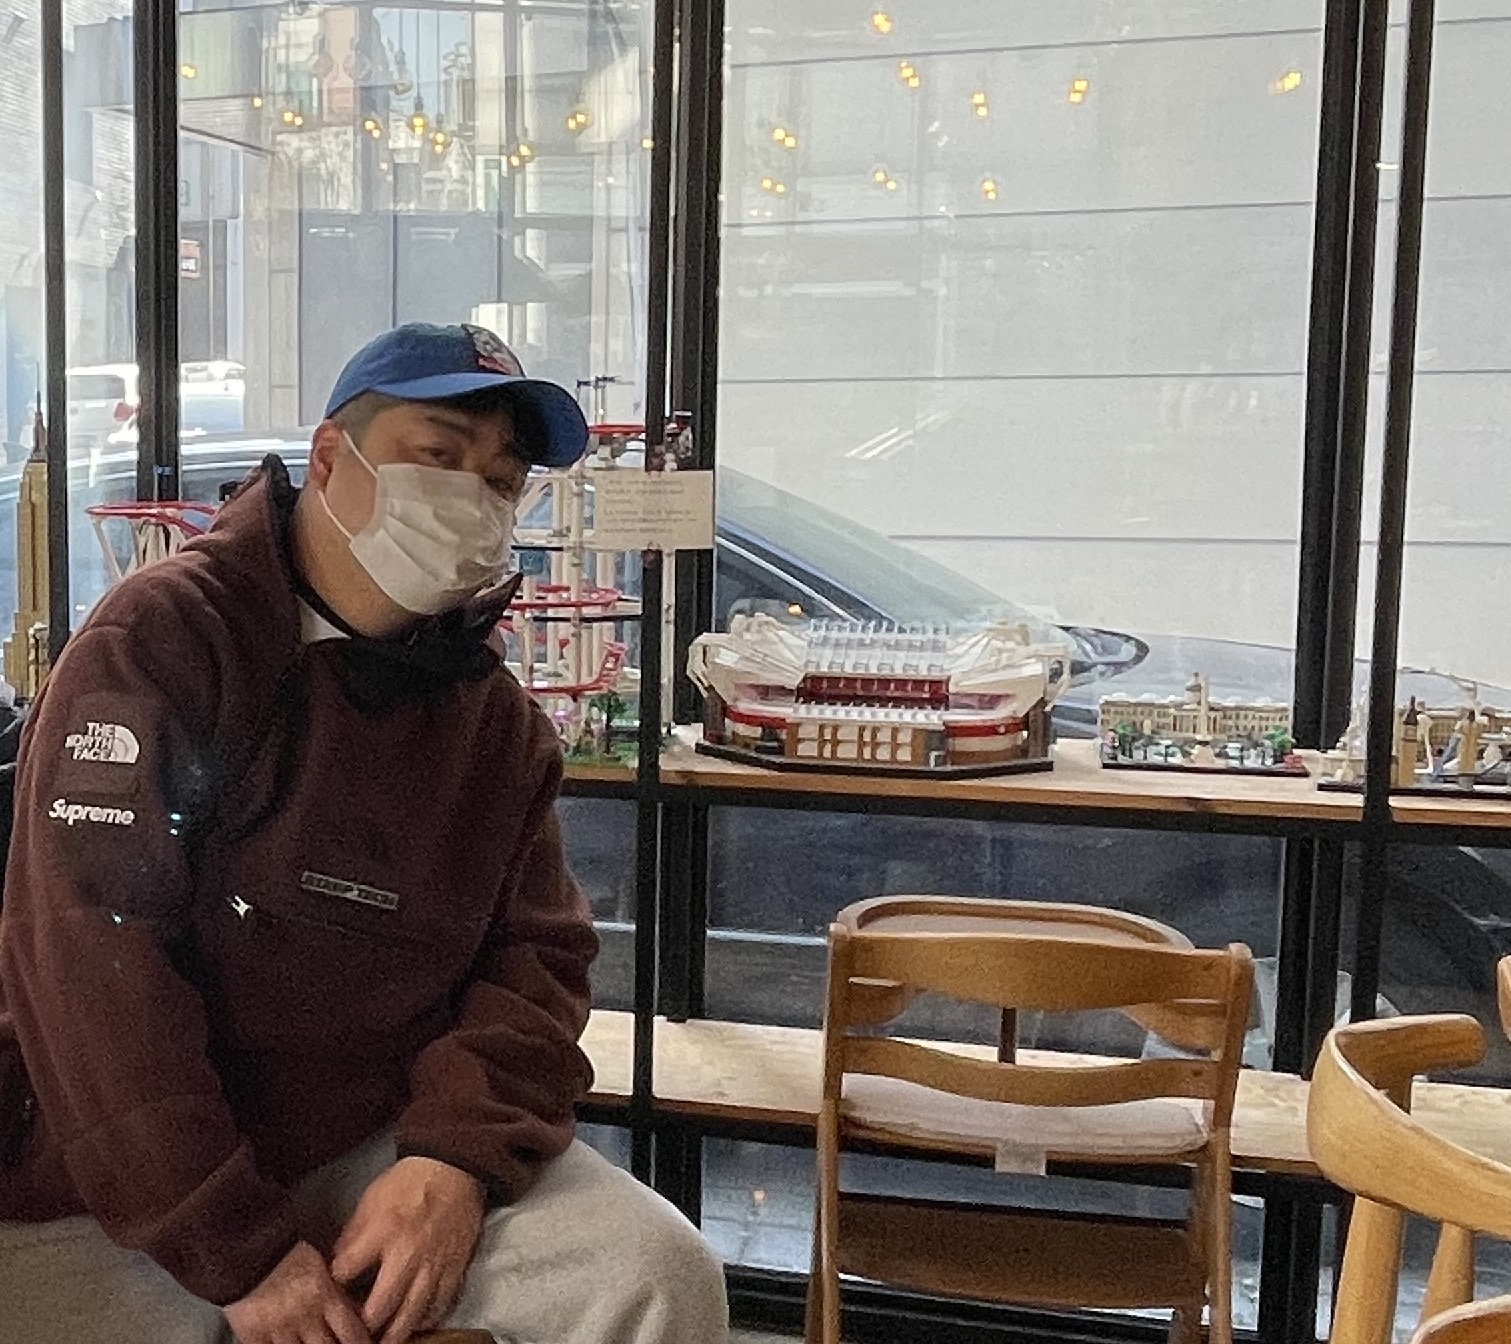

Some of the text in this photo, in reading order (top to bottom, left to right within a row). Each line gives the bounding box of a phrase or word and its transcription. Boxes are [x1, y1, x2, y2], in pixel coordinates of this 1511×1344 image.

[87, 722, 116, 737] THE
[72, 747, 115, 762] FACE
[48, 798, 136, 826] Supreme
